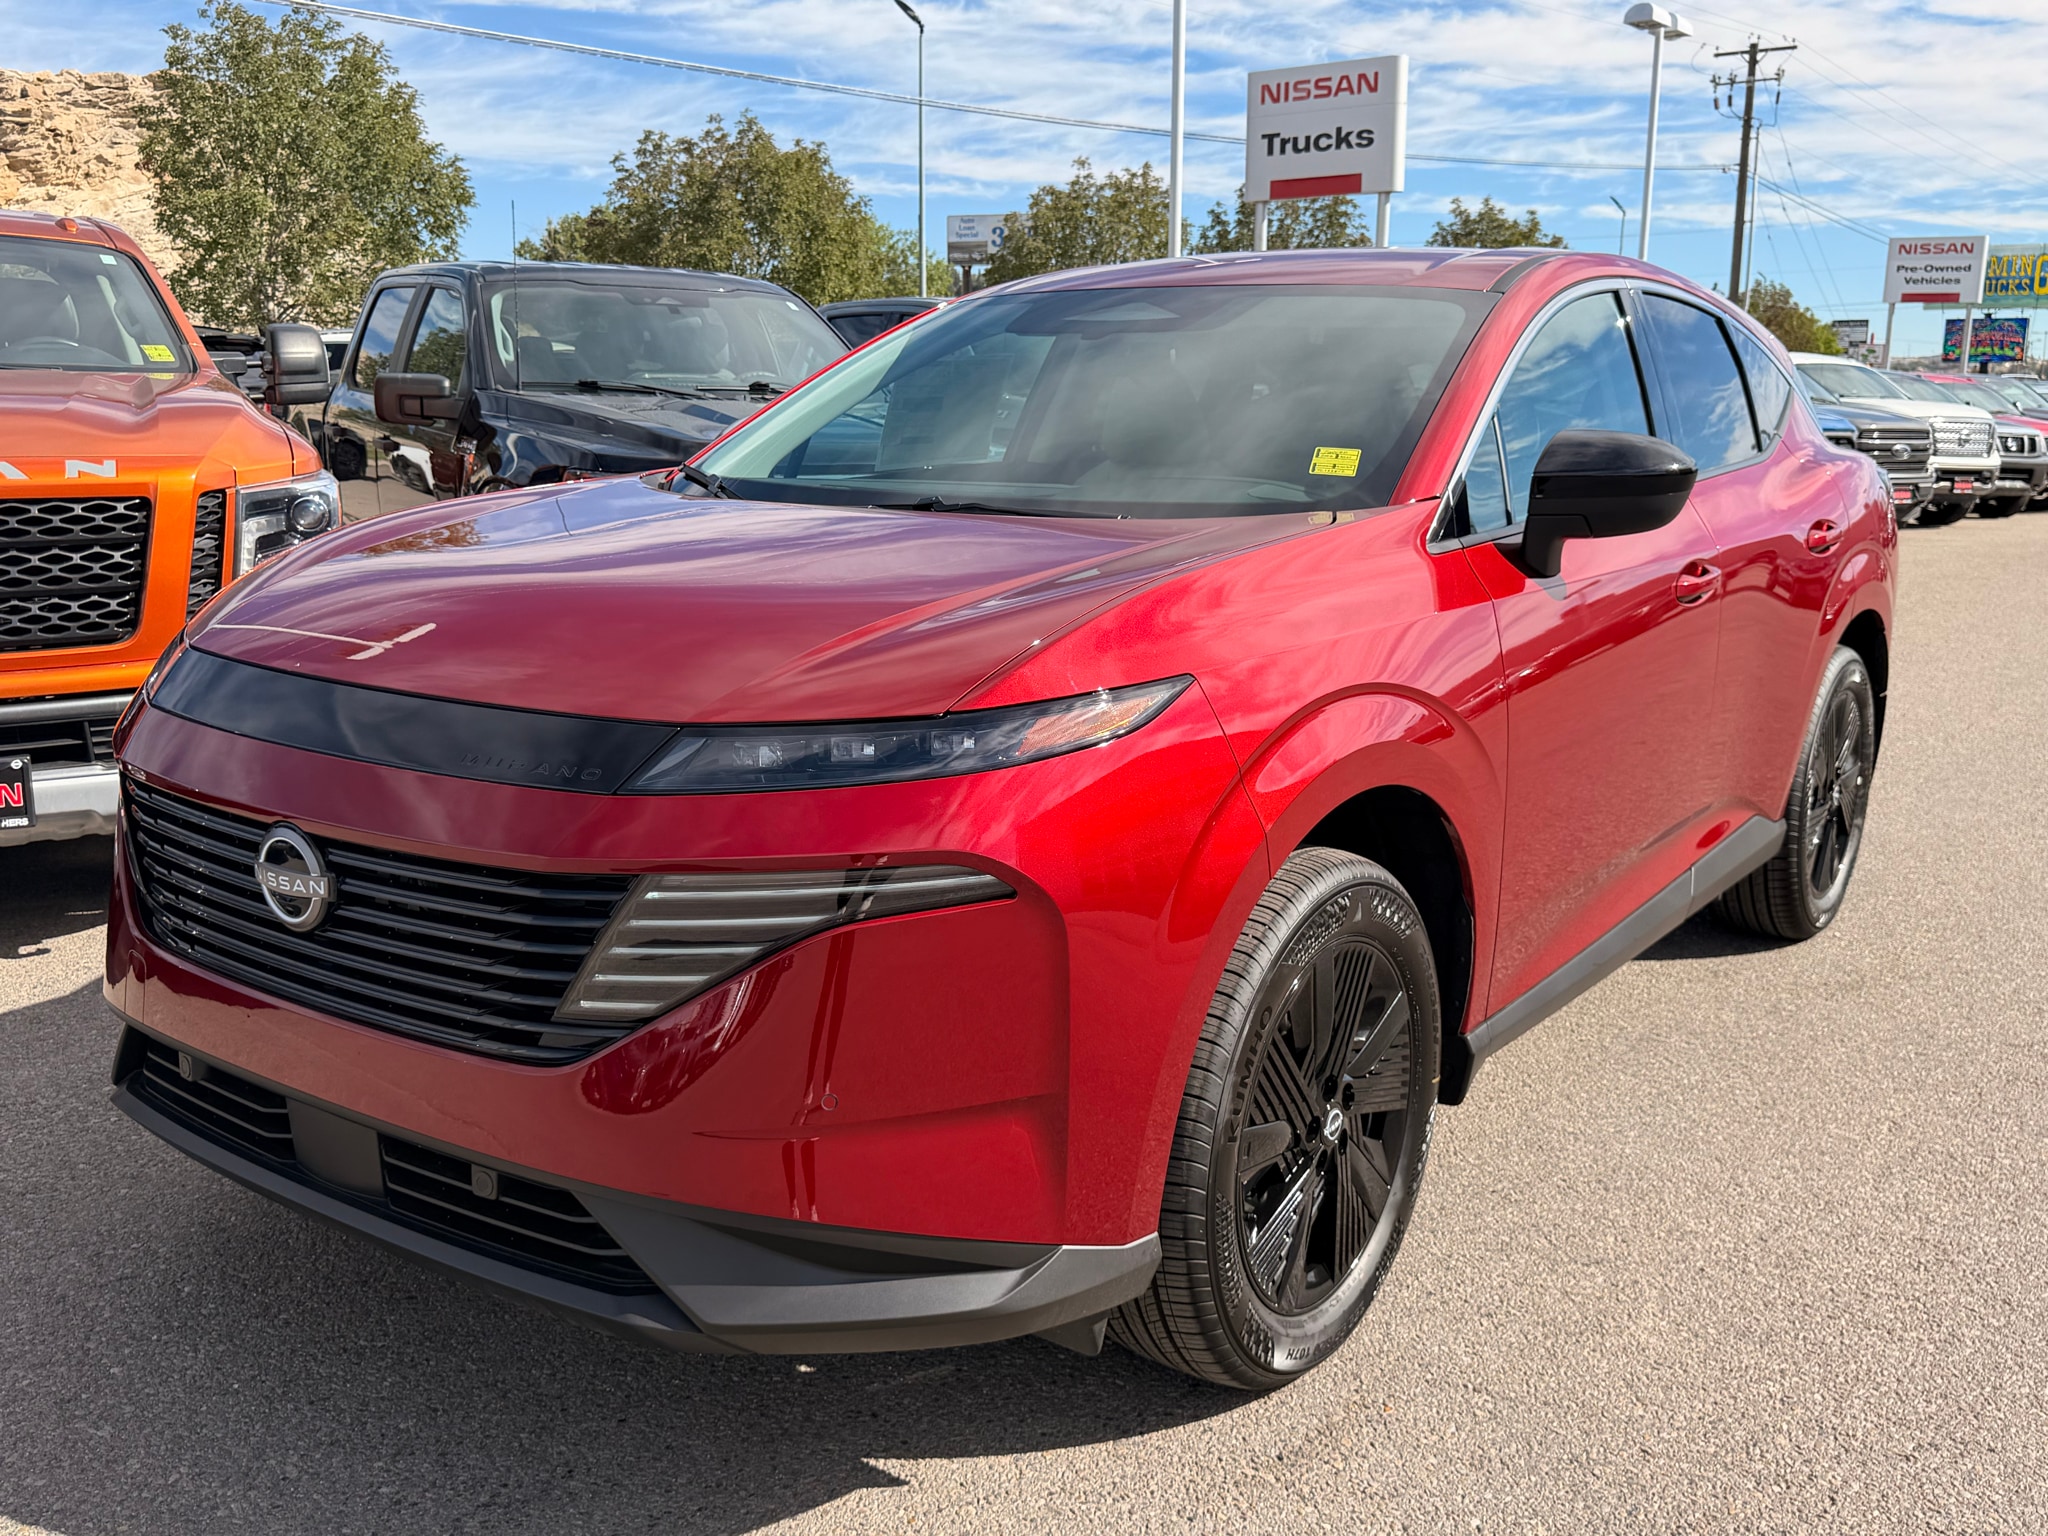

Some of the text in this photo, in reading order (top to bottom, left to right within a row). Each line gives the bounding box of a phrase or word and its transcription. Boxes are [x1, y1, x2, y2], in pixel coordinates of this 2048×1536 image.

[1260, 71, 1378, 105] NISSAN
[1261, 126, 1375, 157] Trucks
[1898, 242, 1974, 255] NISSAN
[1896, 264, 1972, 273] Pre-Owned
[1904, 276, 1961, 285] Vehicles
[460, 753, 602, 781] MURANO
[1227, 1005, 1273, 1143] KUMHO
